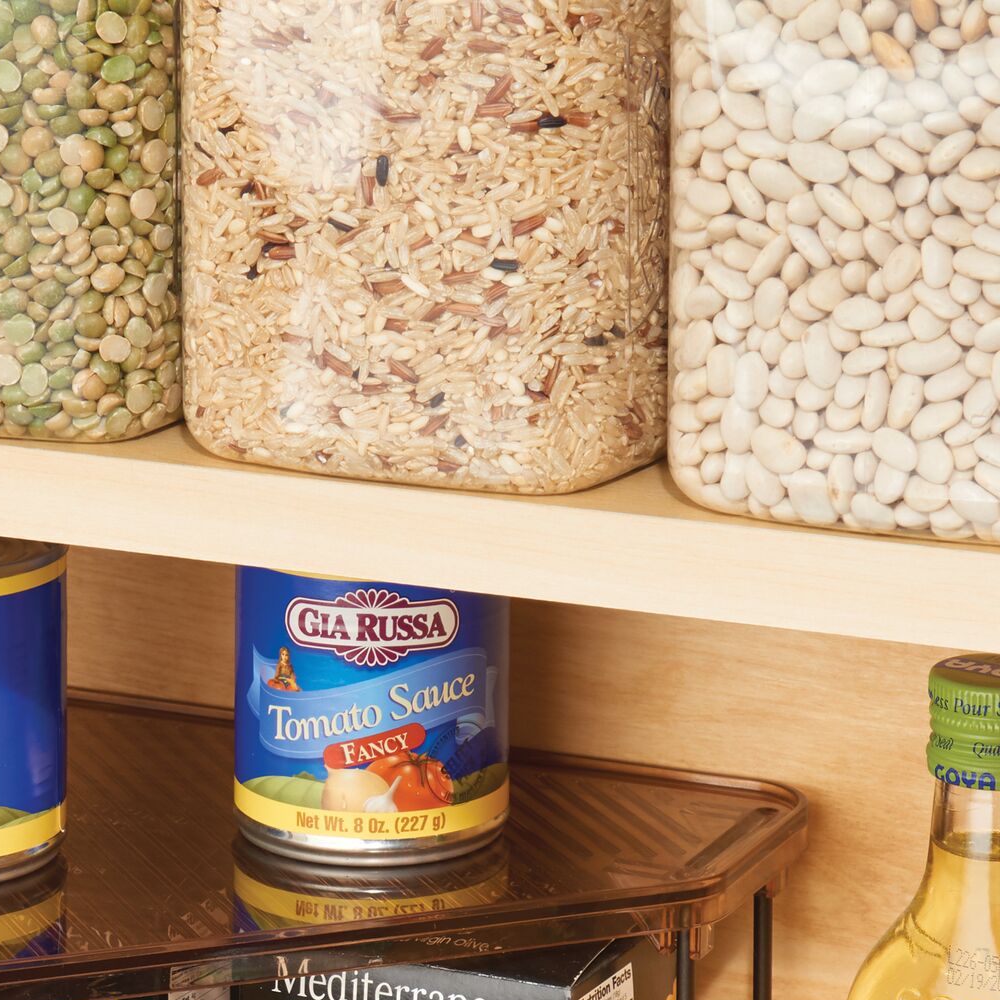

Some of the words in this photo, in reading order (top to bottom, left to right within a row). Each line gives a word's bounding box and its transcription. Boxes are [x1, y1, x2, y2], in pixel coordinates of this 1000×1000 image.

[298, 607, 351, 641] GIA
[356, 611, 448, 643] RUSSA
[267, 704, 383, 741] Tomato
[388, 672, 476, 723] Sauce
[954, 697, 991, 717] Pour
[339, 731, 410, 766] FANCY
[934, 763, 996, 791] GOYA
[296, 811, 320, 831] Net
[324, 814, 349, 834] Wt.
[354, 815, 364, 834] 8
[368, 815, 390, 834] Oz.
[395, 814, 428, 835] (227
[432, 812, 447, 832] g)
[612, 968, 632, 990] Facts
